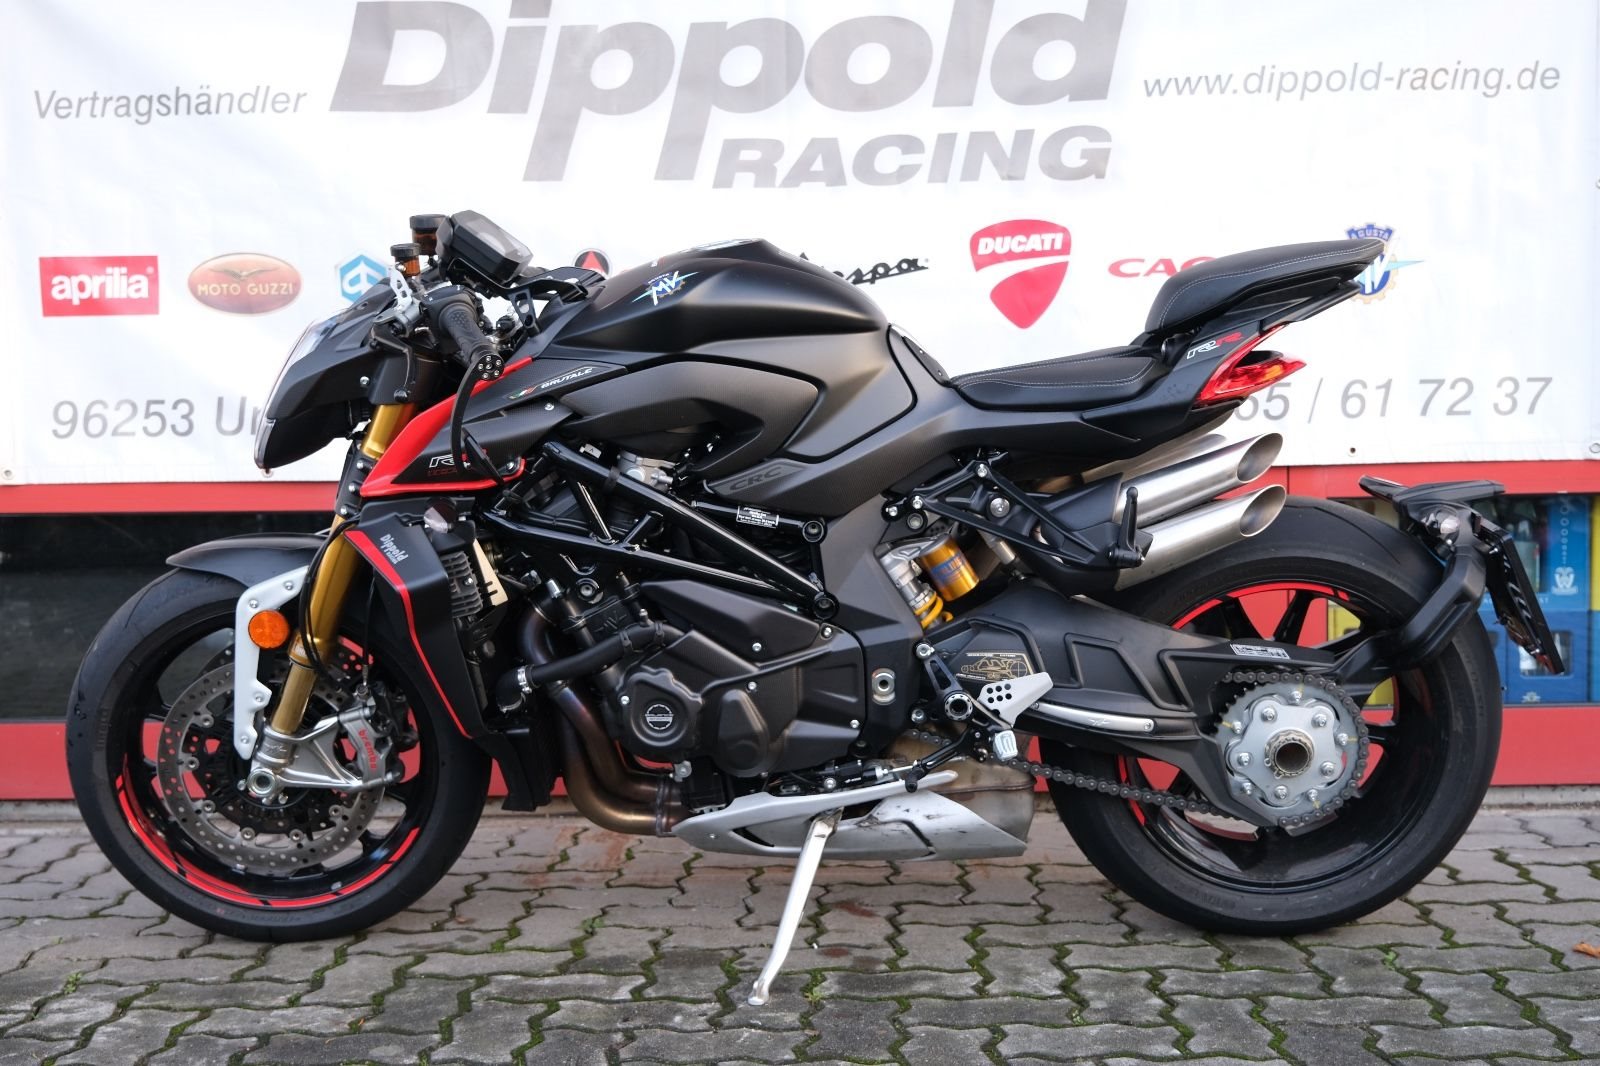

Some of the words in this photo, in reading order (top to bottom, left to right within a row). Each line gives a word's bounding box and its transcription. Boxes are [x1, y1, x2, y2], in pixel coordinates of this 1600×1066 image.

[329, 0, 1128, 181] Dippold
[1143, 60, 1561, 102] www.dippold-racing.de
[34, 85, 308, 126] Vertragshändler
[712, 125, 1112, 189] RACING
[977, 232, 1064, 256] DUCATI
[51, 266, 149, 306] aprilia
[197, 283, 241, 296] MOTO
[247, 282, 294, 296] GUZZI
[541, 366, 593, 389] BRUTALE
[51, 398, 196, 440] 96253
[1307, 377, 1324, 424] /
[1340, 378, 1393, 419] 61
[1418, 376, 1475, 417] 72
[1493, 376, 1553, 417] 37
[729, 465, 782, 491] CRC
[380, 533, 409, 562] Dippold
